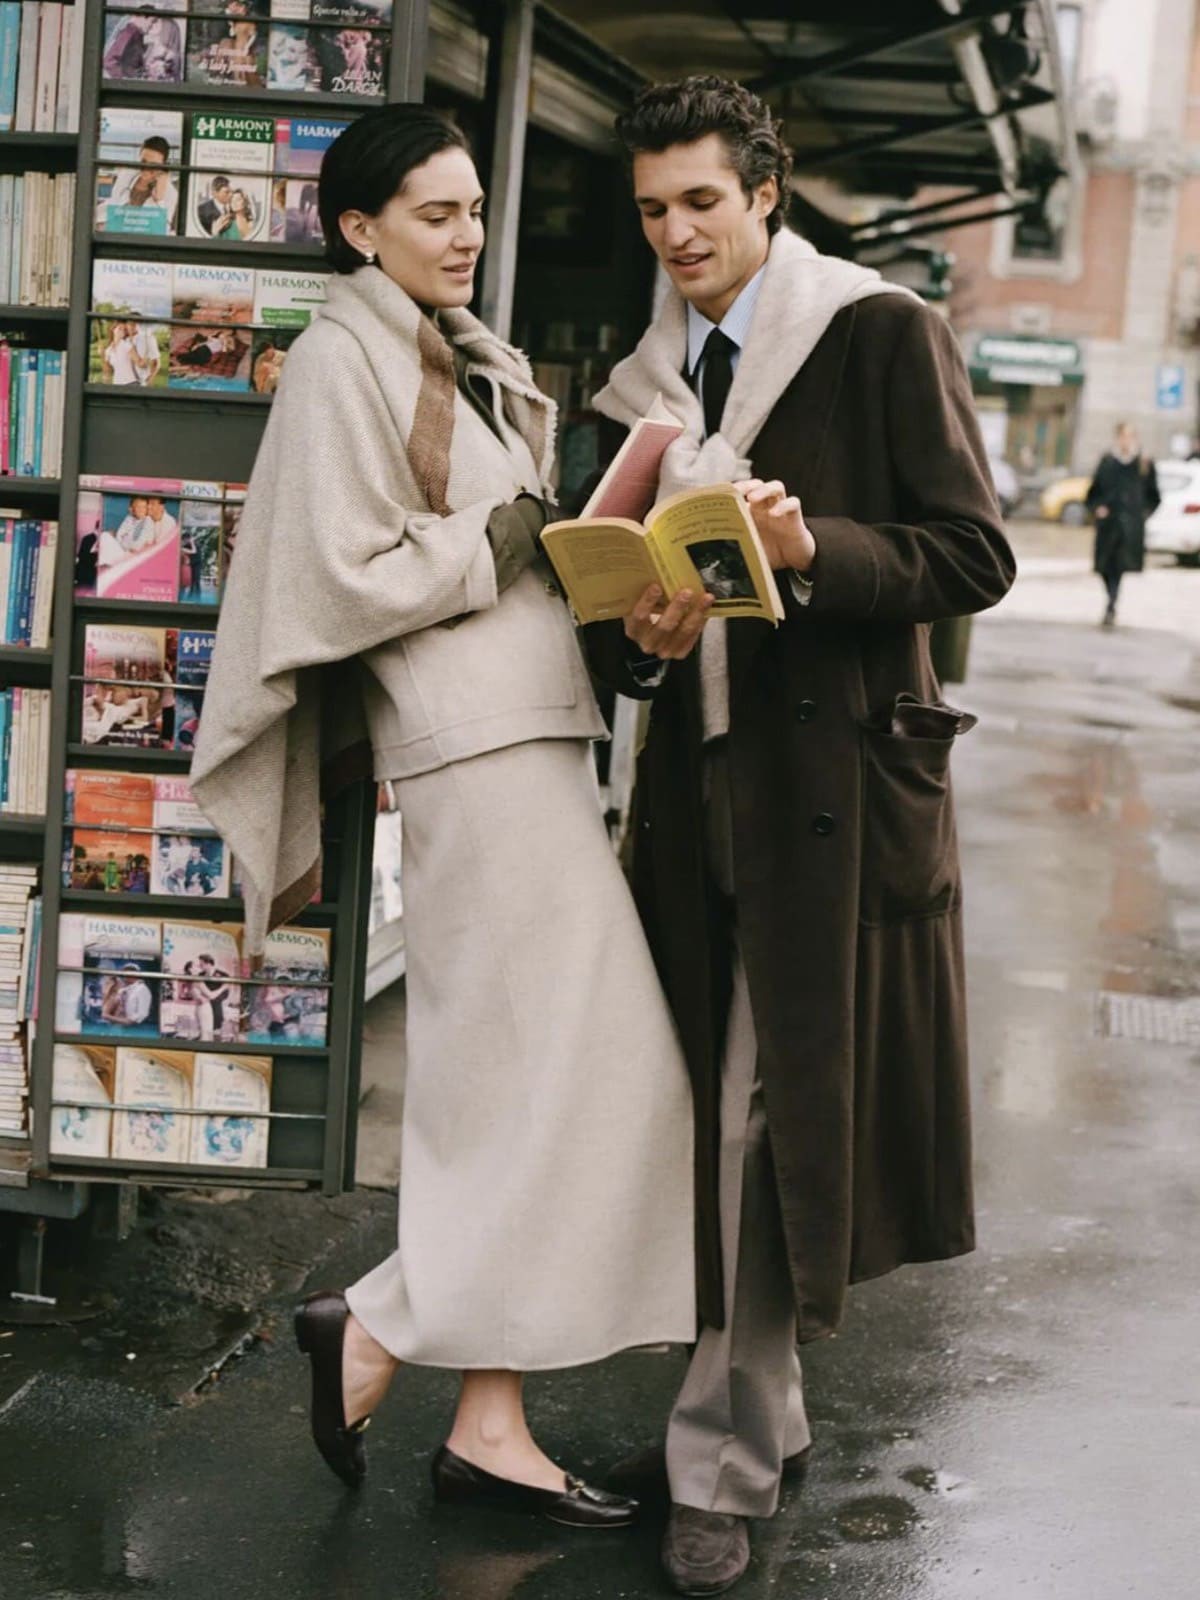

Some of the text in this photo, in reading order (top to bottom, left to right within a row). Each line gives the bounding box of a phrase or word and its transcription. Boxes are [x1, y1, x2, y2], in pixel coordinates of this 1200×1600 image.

[196, 116, 272, 137] HARMONY
[225, 129, 272, 140] JOLLY
[296, 124, 345, 139] HARM
[102, 263, 166, 277] HARMONY
[177, 267, 250, 283] HARMONY
[88, 921, 157, 937] HARMONY
[267, 931, 323, 948] ARMONY
